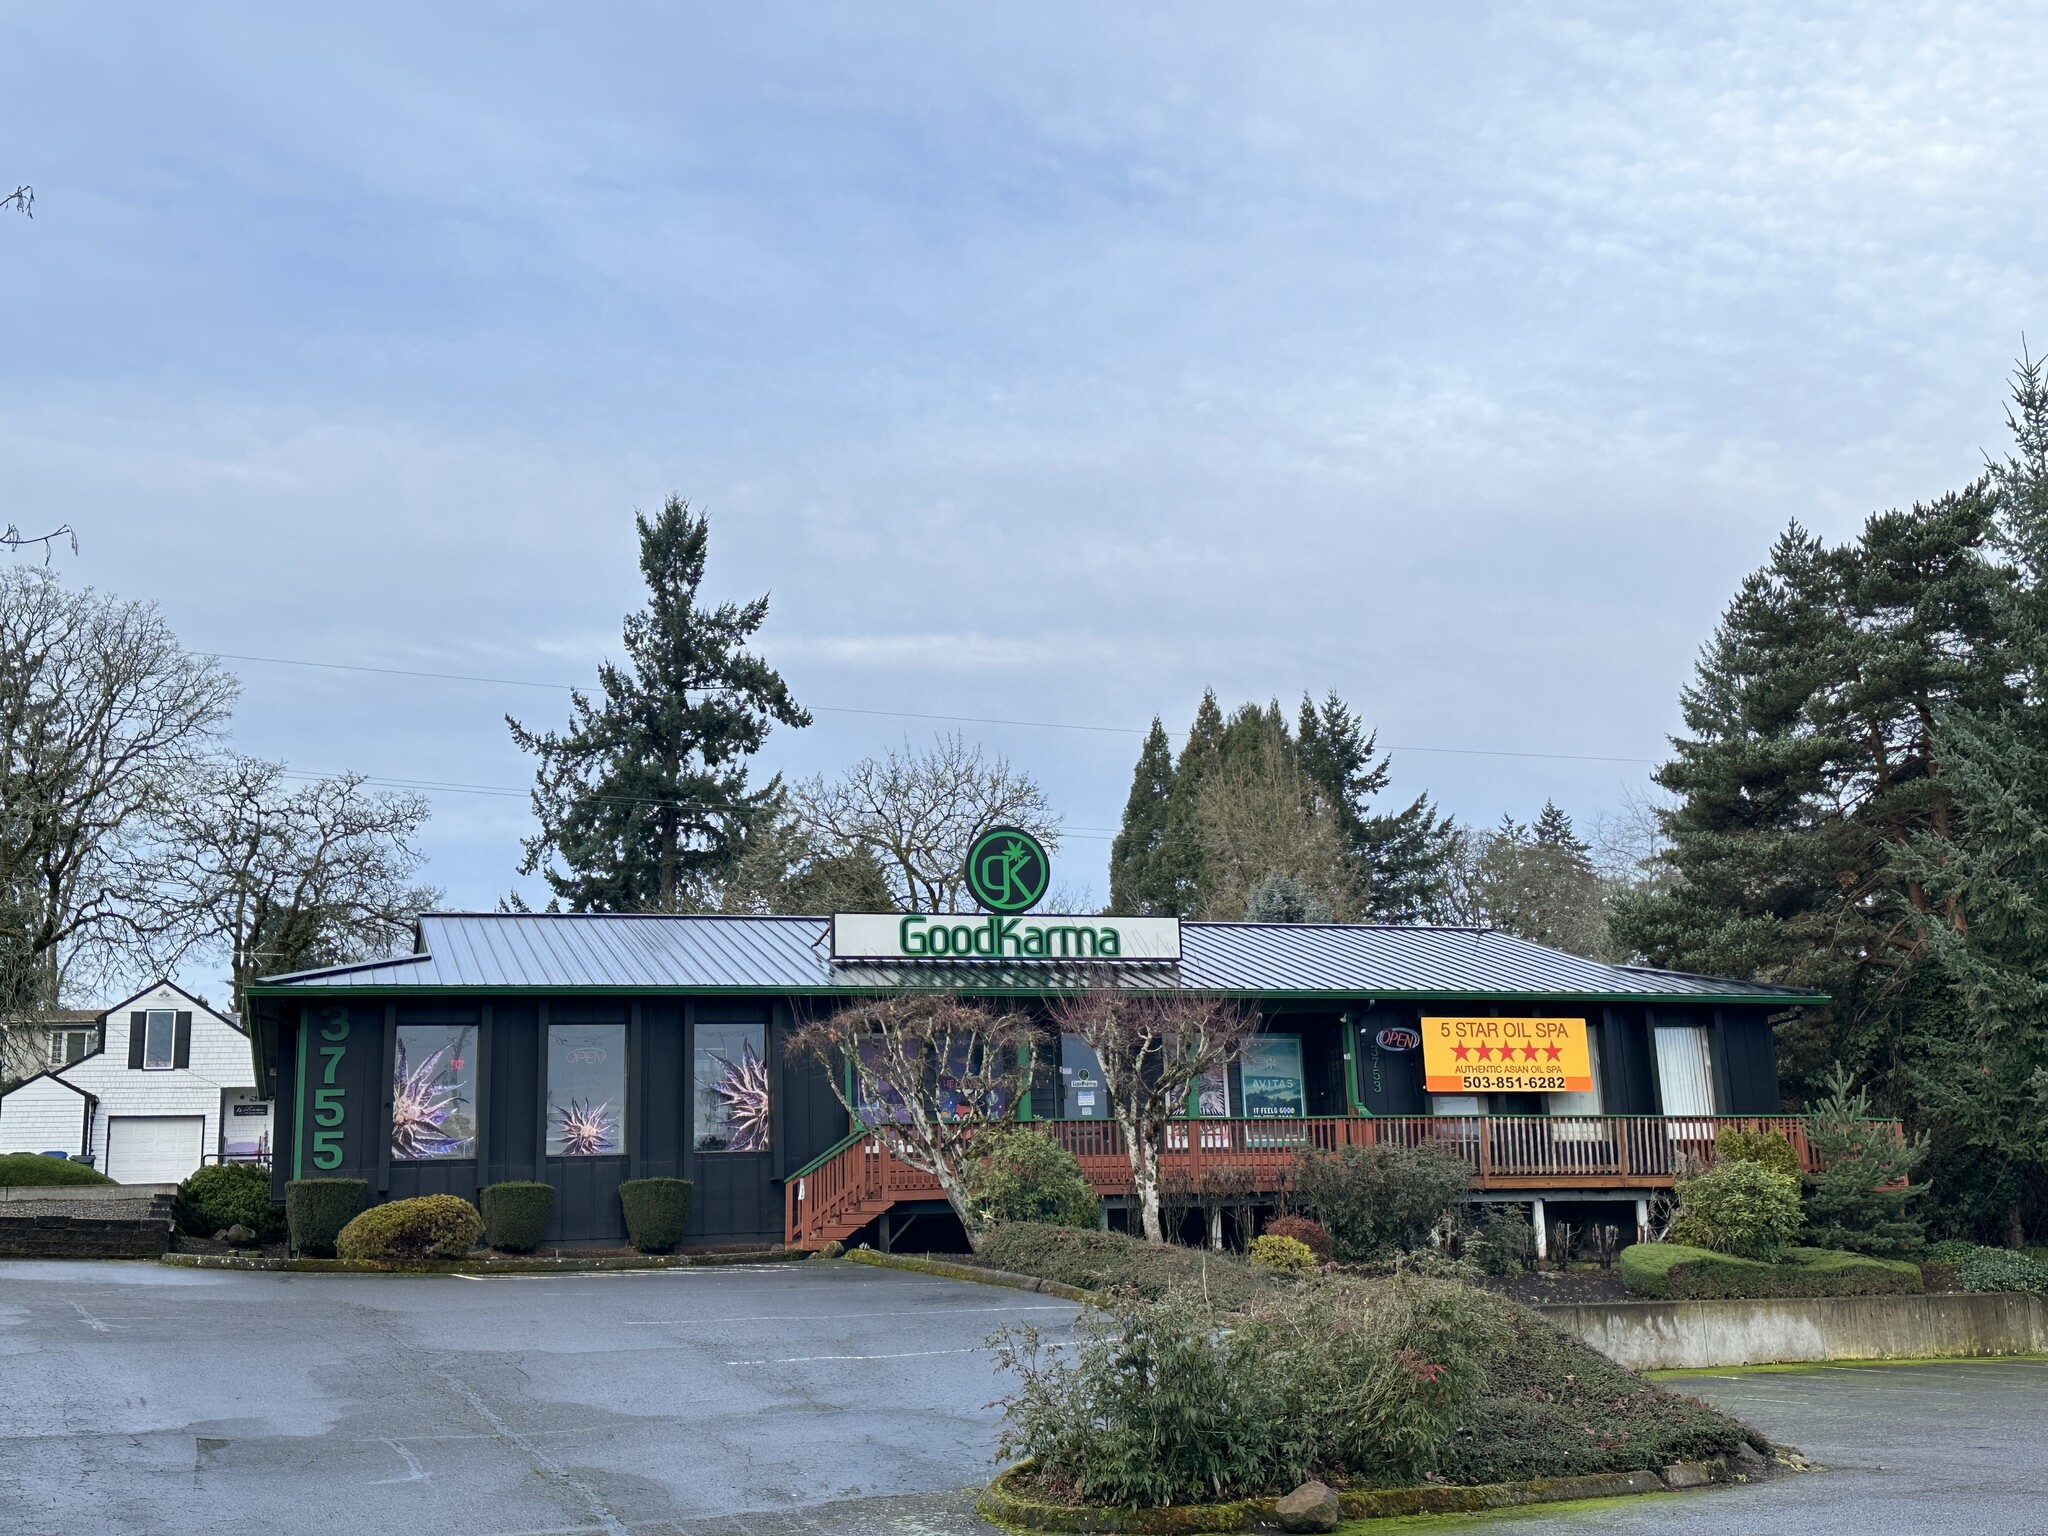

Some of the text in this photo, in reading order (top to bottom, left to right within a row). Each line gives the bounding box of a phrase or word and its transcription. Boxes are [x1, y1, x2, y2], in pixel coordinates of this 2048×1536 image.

[1441, 1022, 1569, 1038] 5 STAR OIL SPA
[1381, 1030, 1414, 1048] OPEN
[567, 1051, 605, 1064] OPEN
[1455, 1065, 1562, 1074] AUTHENTIC ASIAN OIL SPA
[313, 1005, 351, 1170] 3755
[1252, 1079, 1294, 1088] AVITAS
[1463, 1076, 1565, 1089] 503-851-6282
